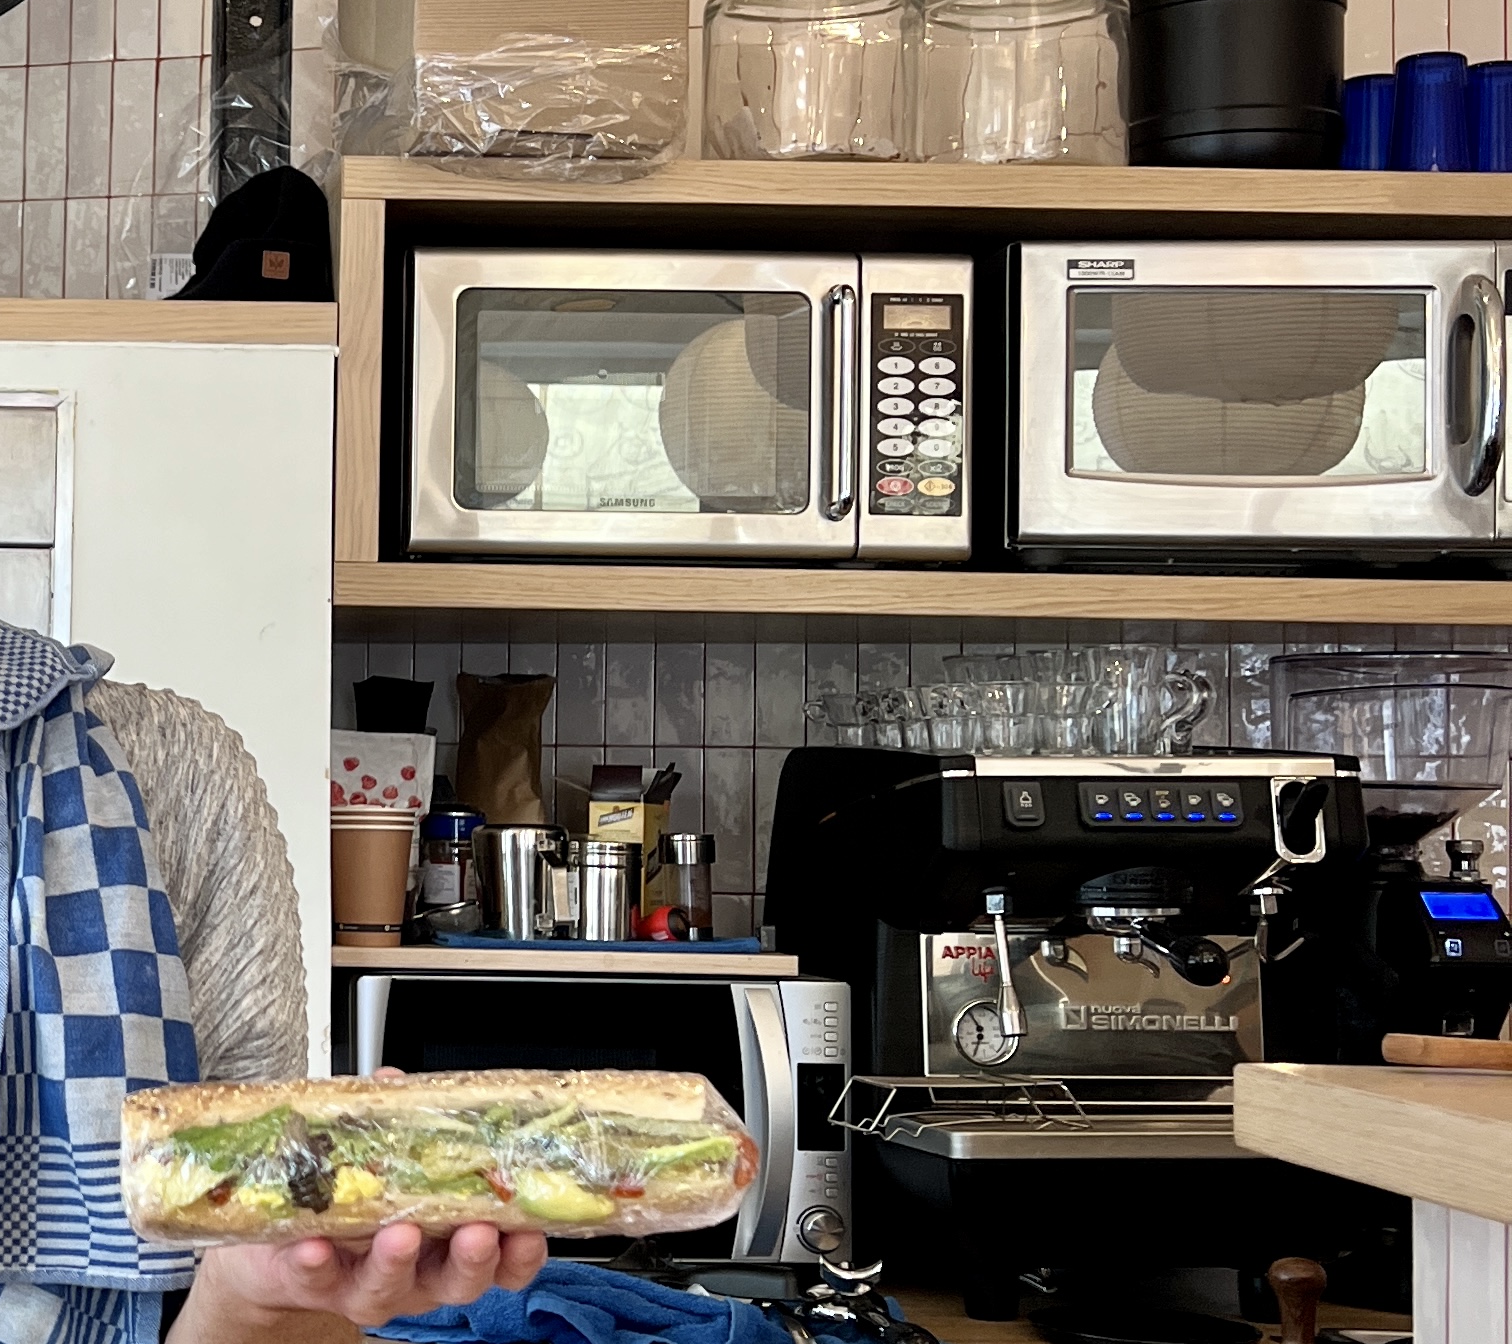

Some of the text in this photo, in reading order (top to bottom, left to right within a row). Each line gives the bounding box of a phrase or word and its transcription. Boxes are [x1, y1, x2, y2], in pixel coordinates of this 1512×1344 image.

[1077, 260, 1125, 268] SHARP
[599, 497, 656, 508] SAMSUNG
[941, 945, 996, 959] APPIA
[1090, 1003, 1142, 1014] nuova
[1091, 1014, 1239, 1031] SIMONELLI
